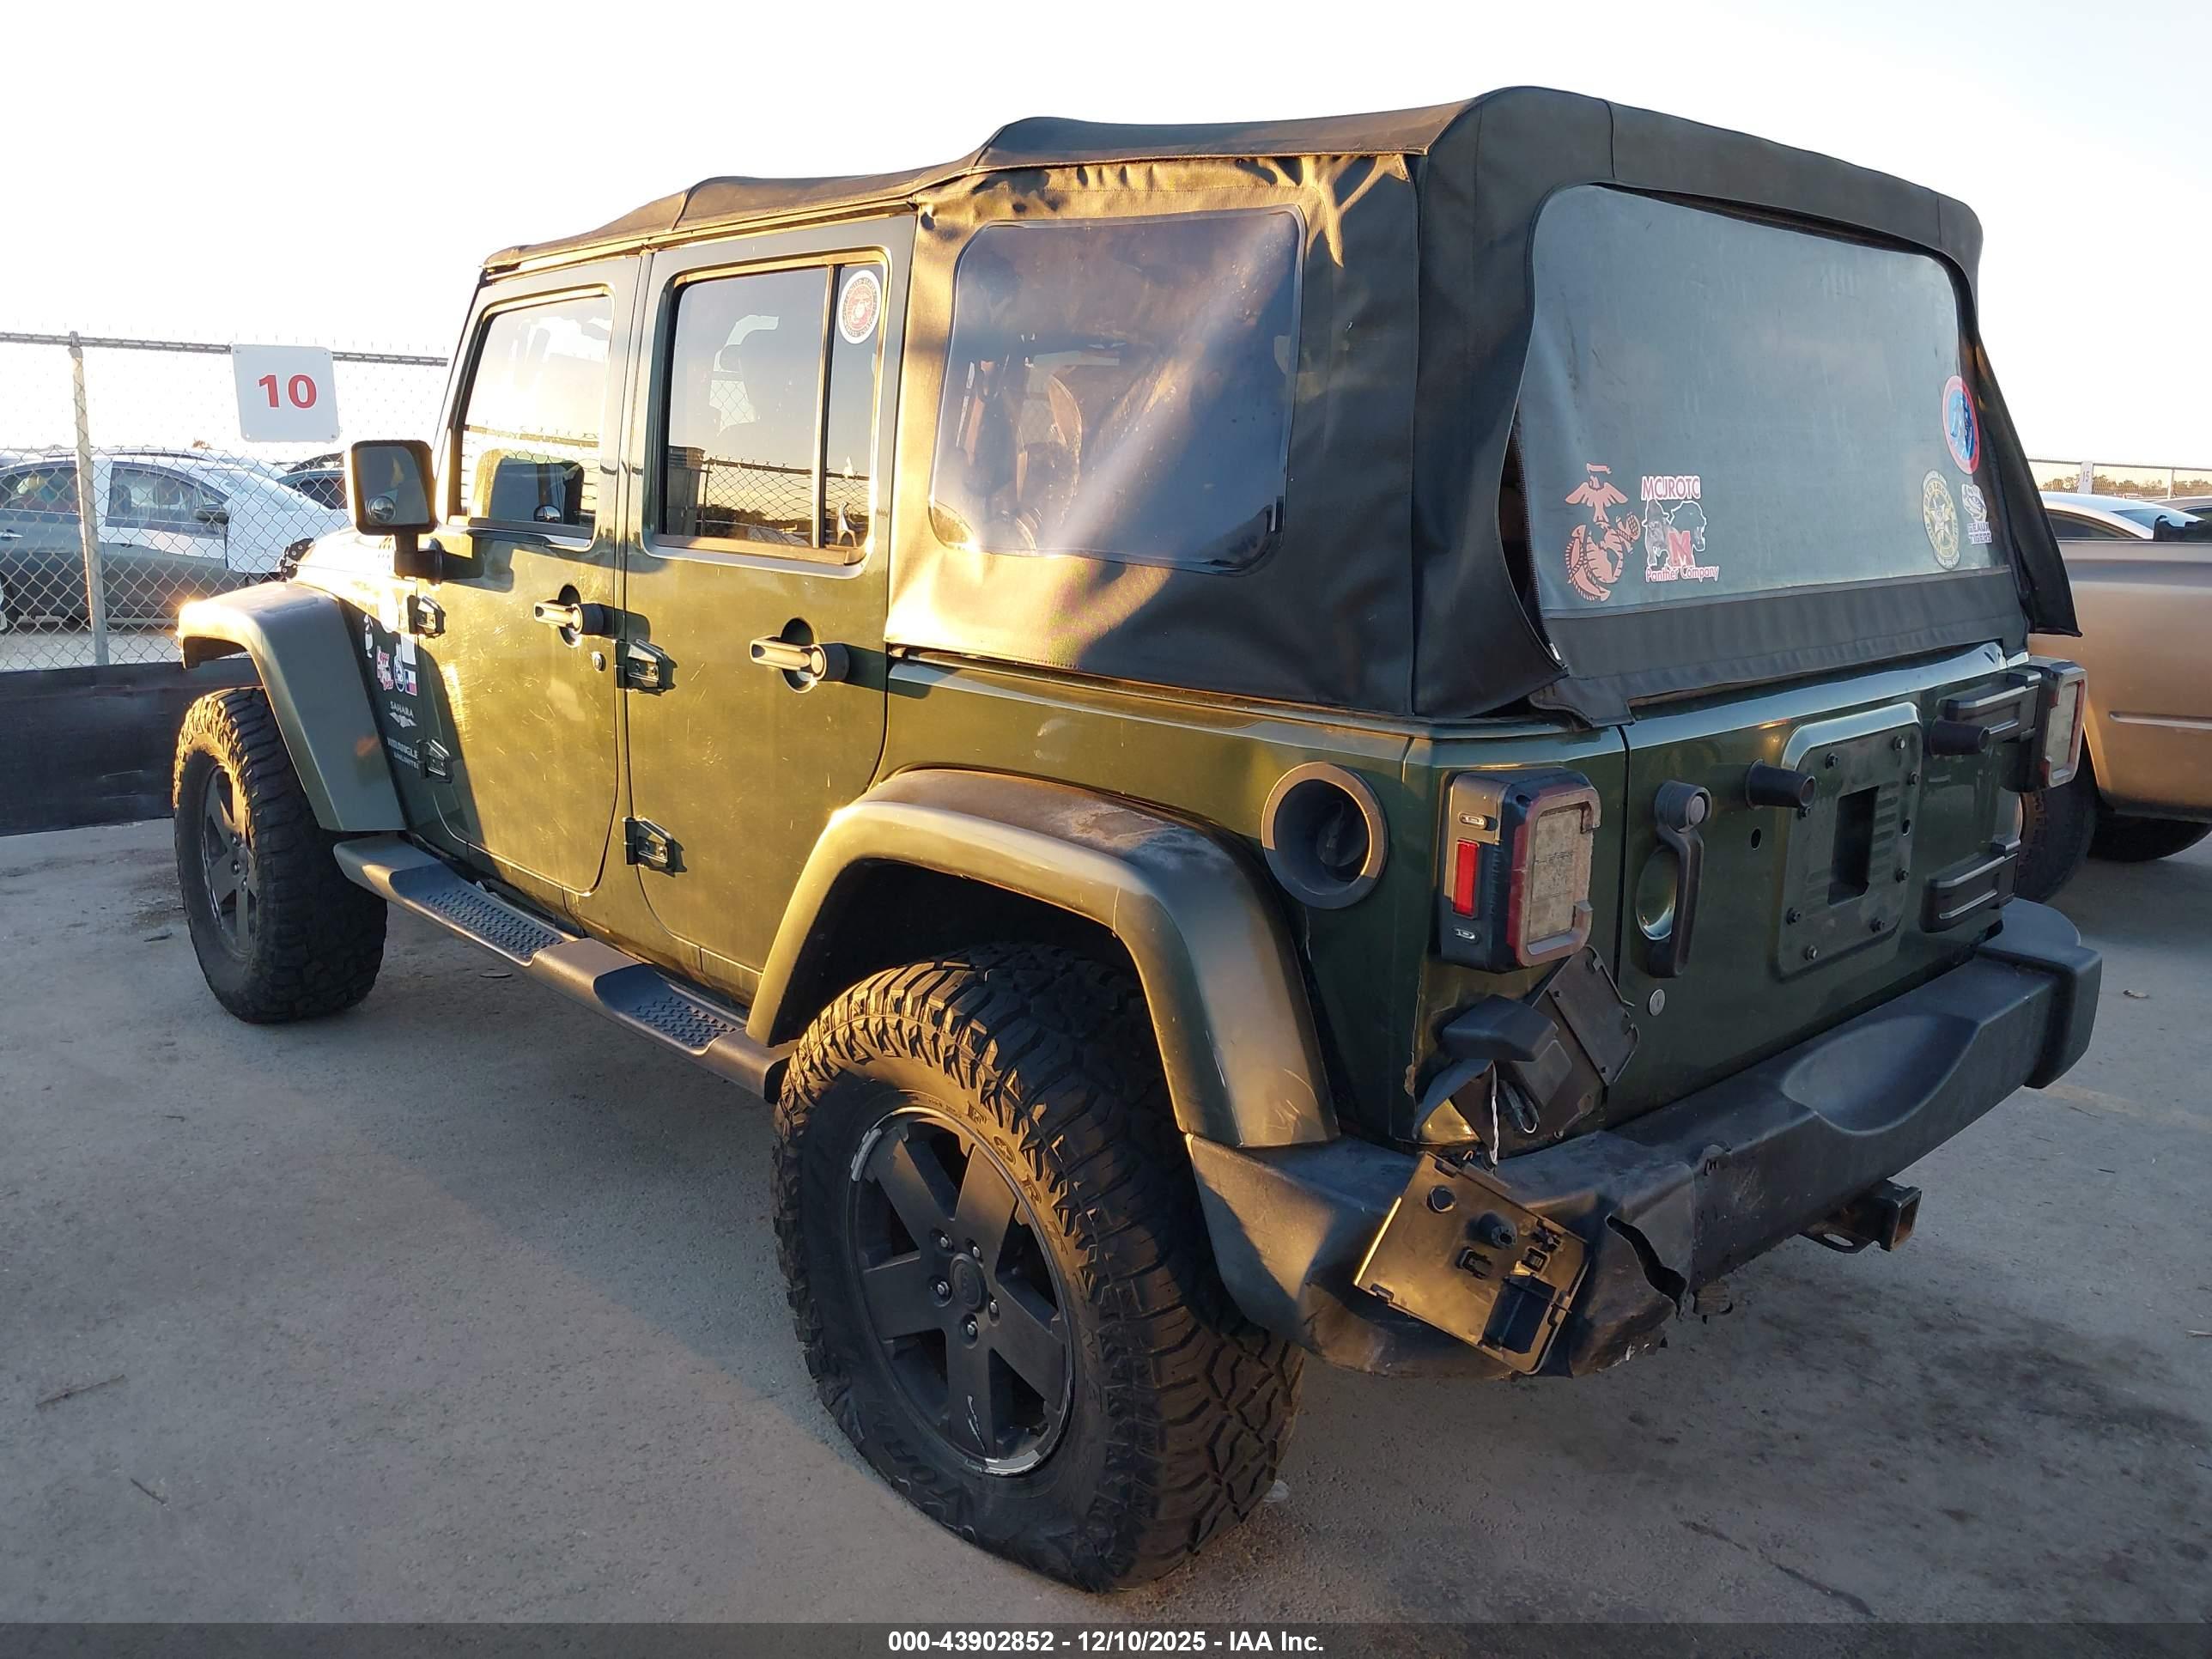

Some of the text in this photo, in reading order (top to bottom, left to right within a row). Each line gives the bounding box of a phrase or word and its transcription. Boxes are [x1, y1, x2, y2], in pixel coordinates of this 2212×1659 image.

[258, 374, 318, 409] 10
[2081, 471, 2090, 483] 15
[1642, 477, 1701, 499] MCJROTC
[1646, 564, 1719, 582] Panther Company
[390, 701, 414, 719] SAHARA
